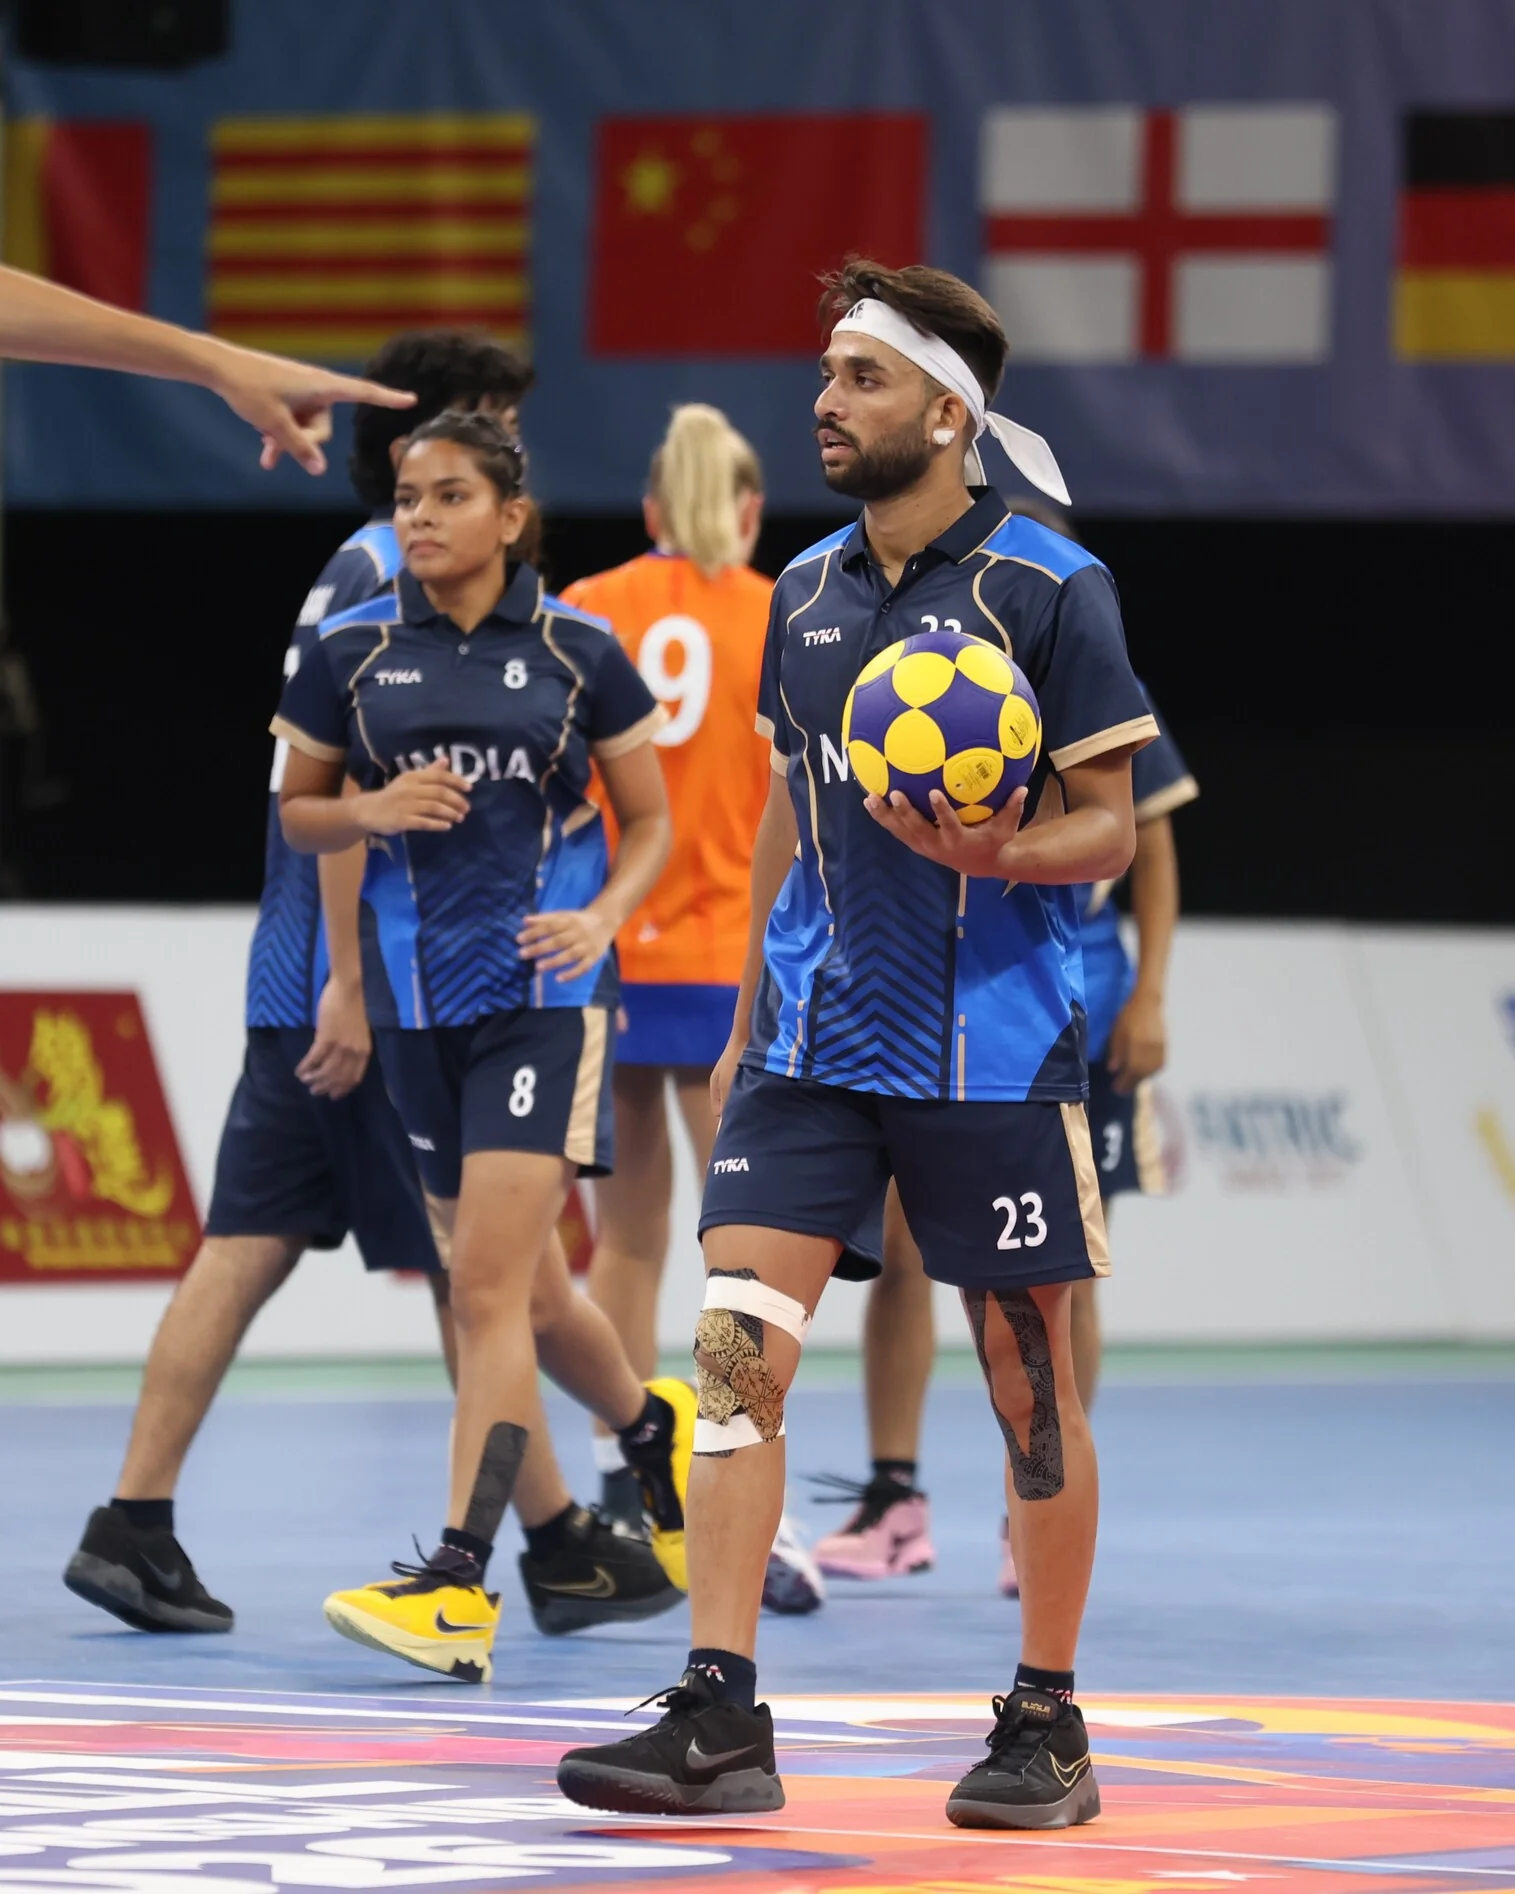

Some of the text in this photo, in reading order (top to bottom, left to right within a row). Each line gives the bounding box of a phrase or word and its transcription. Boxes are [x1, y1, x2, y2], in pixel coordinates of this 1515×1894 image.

[803, 627, 841, 647] TYKA
[374, 668, 423, 686] TYKA
[503, 658, 528, 690] 8
[638, 615, 712, 747] 9
[508, 1066, 536, 1117] 8
[713, 1157, 749, 1175] TYKA
[992, 1192, 1047, 1250] 23
